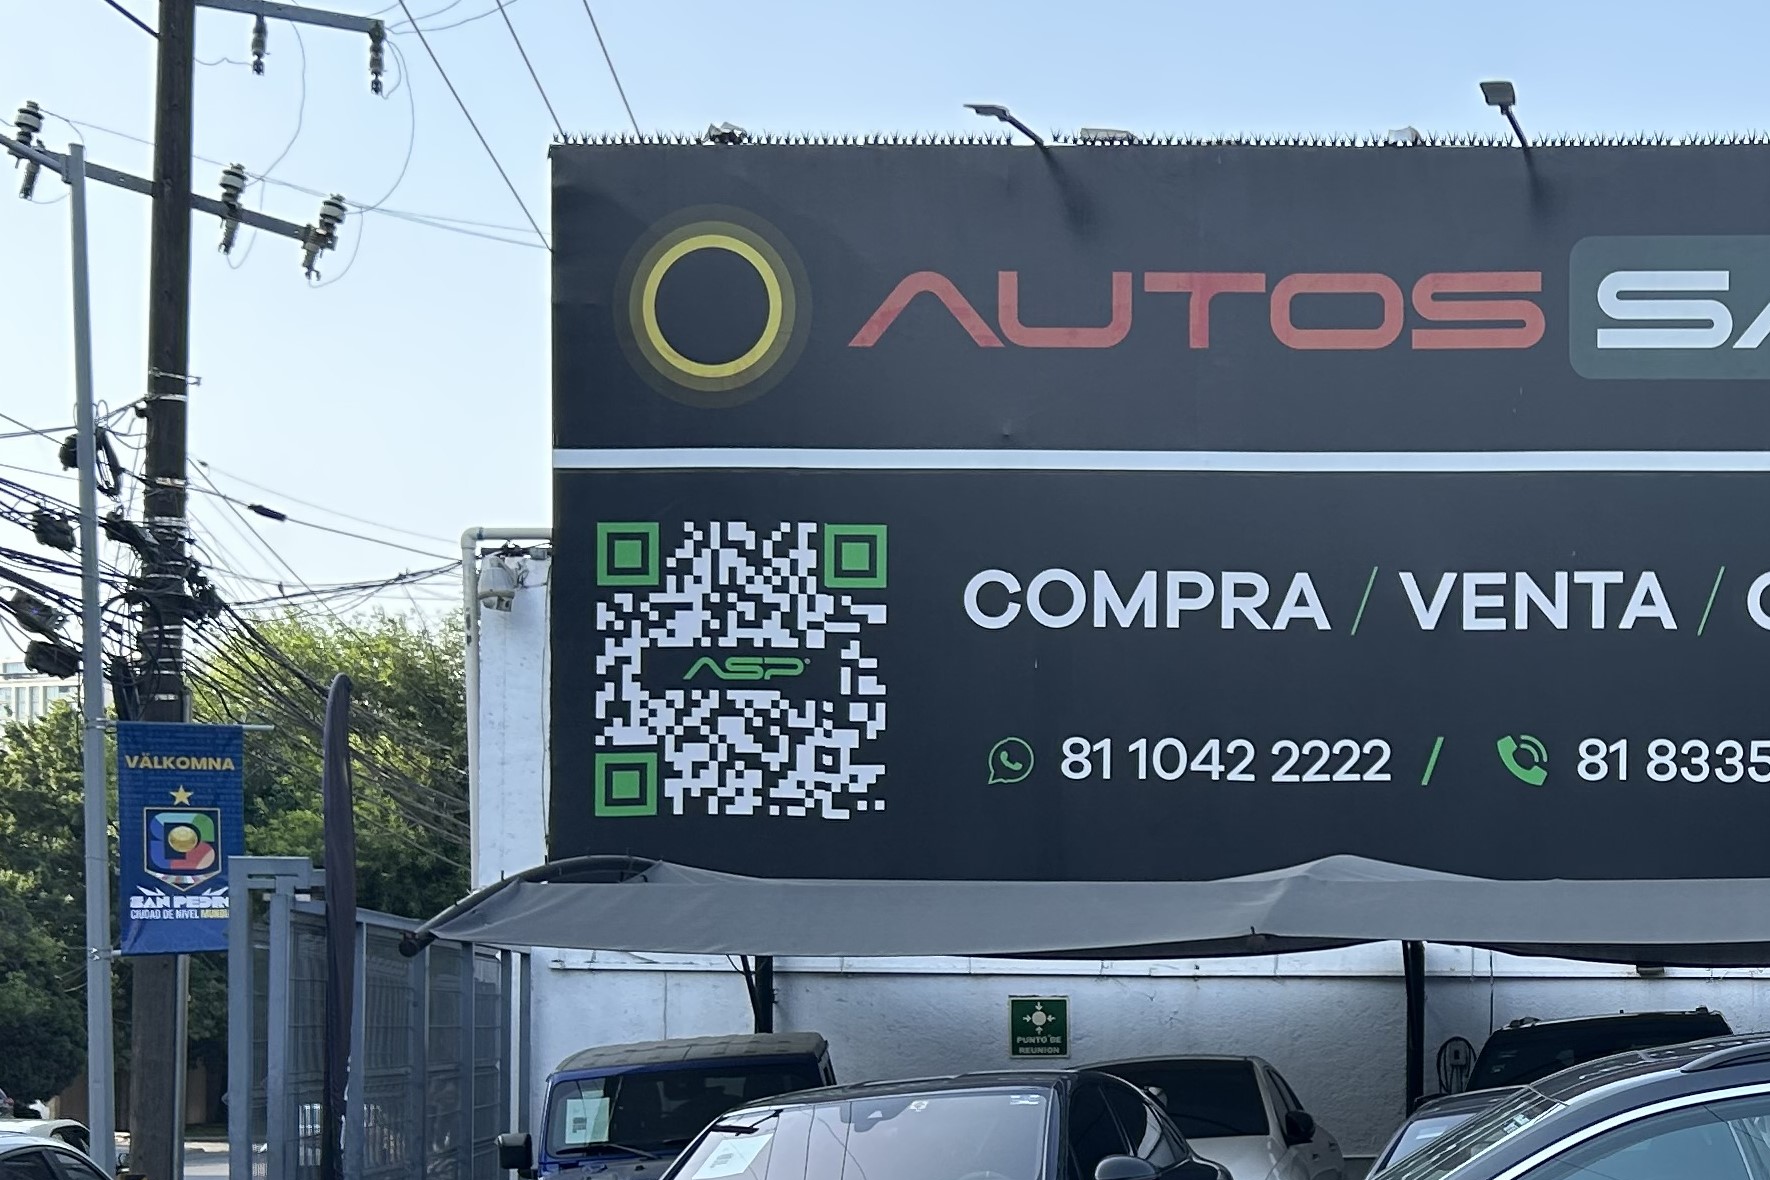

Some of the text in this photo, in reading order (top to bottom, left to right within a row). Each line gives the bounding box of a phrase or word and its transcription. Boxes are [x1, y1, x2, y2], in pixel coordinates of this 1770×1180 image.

[849, 271, 1545, 350] AUTOS
[963, 568, 1332, 632] COMPRA
[1399, 570, 1679, 632] VENTA
[683, 656, 805, 681] ASP
[125, 752, 235, 770] VÄLKOMNA
[1061, 736, 1111, 781] 81
[1128, 737, 1257, 782] 1042
[1271, 738, 1392, 783] 2222
[1577, 738, 1627, 781] 81
[130, 895, 170, 909] SAN
